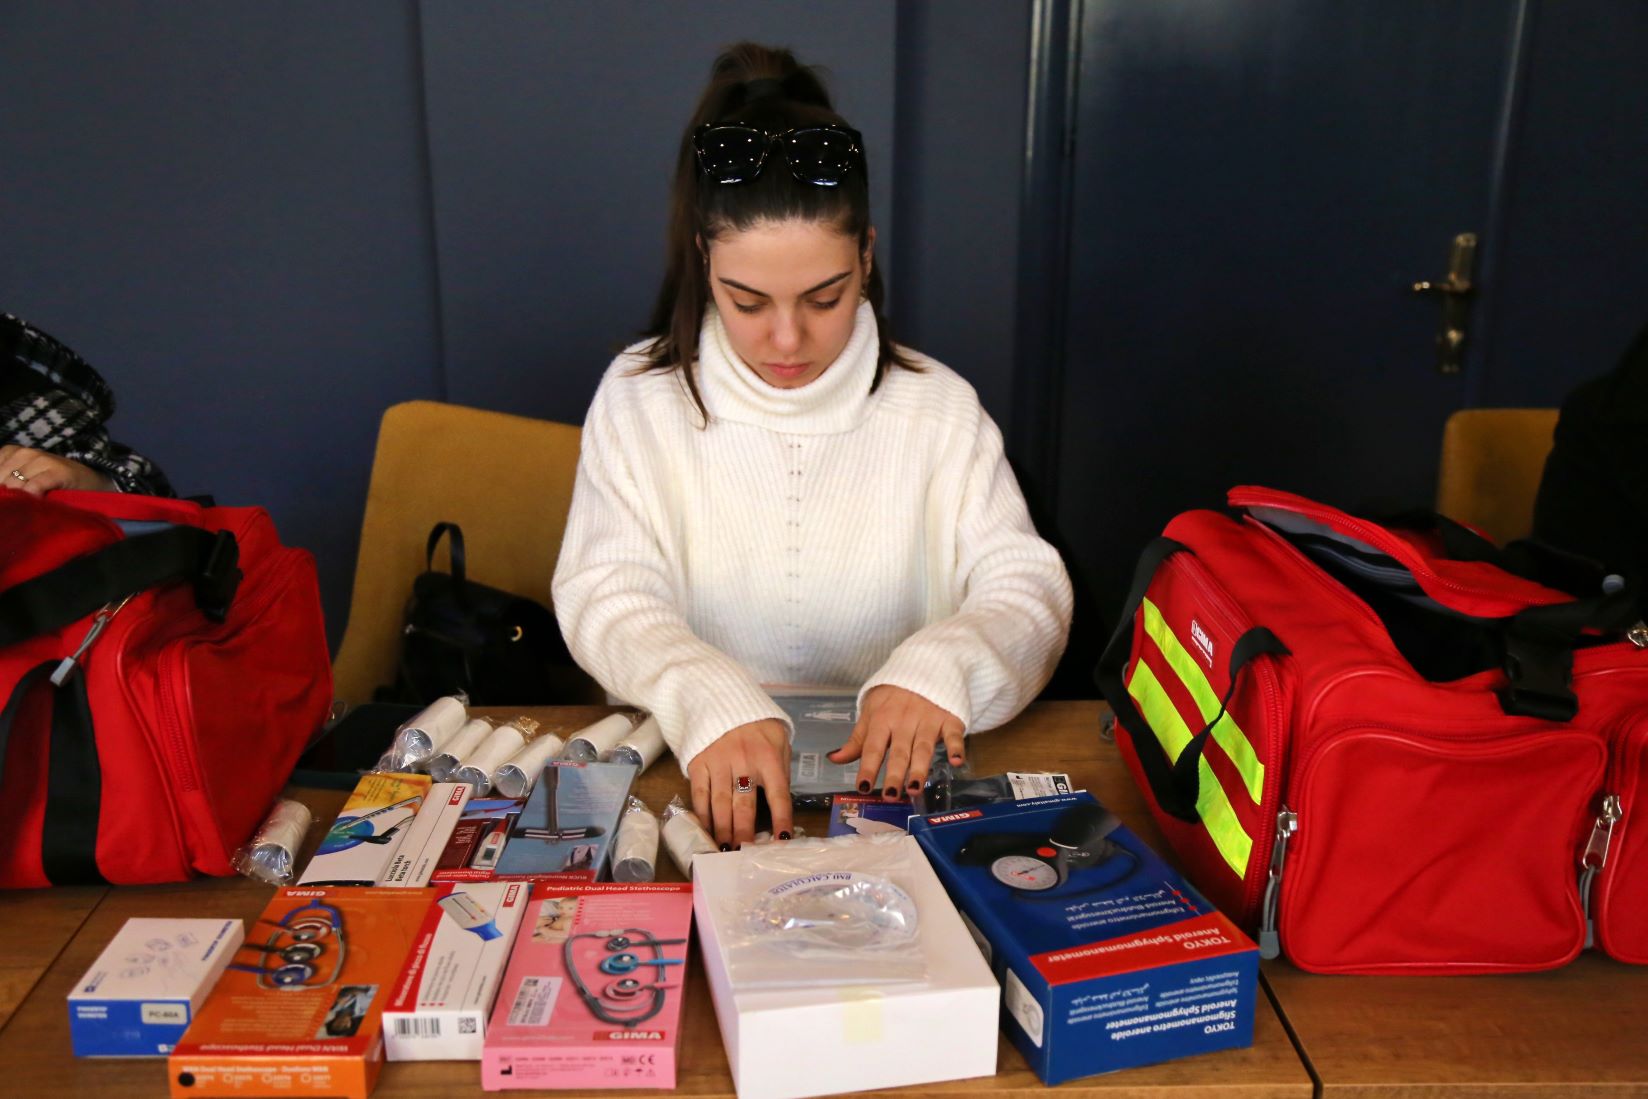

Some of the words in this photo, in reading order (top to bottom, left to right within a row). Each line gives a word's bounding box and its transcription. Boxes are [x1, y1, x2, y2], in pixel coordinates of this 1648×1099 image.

[1197, 626, 1213, 657] GIMA
[451, 787, 465, 801] GIMA
[930, 812, 970, 824] GIMA
[506, 885, 519, 902] GIMA
[1172, 927, 1220, 941] Aneroid
[1047, 932, 1171, 963] Sphygmomanometer
[1183, 935, 1231, 950] TOKYO
[1201, 999, 1237, 1013] Aneroid
[1105, 1004, 1200, 1031] Sphygmomanometer
[1153, 1010, 1237, 1034] Sfigmomanometro
[609, 1031, 661, 1040] GIMA
[1110, 1025, 1152, 1041] aneroide
[1203, 1021, 1236, 1035] TOKYO
